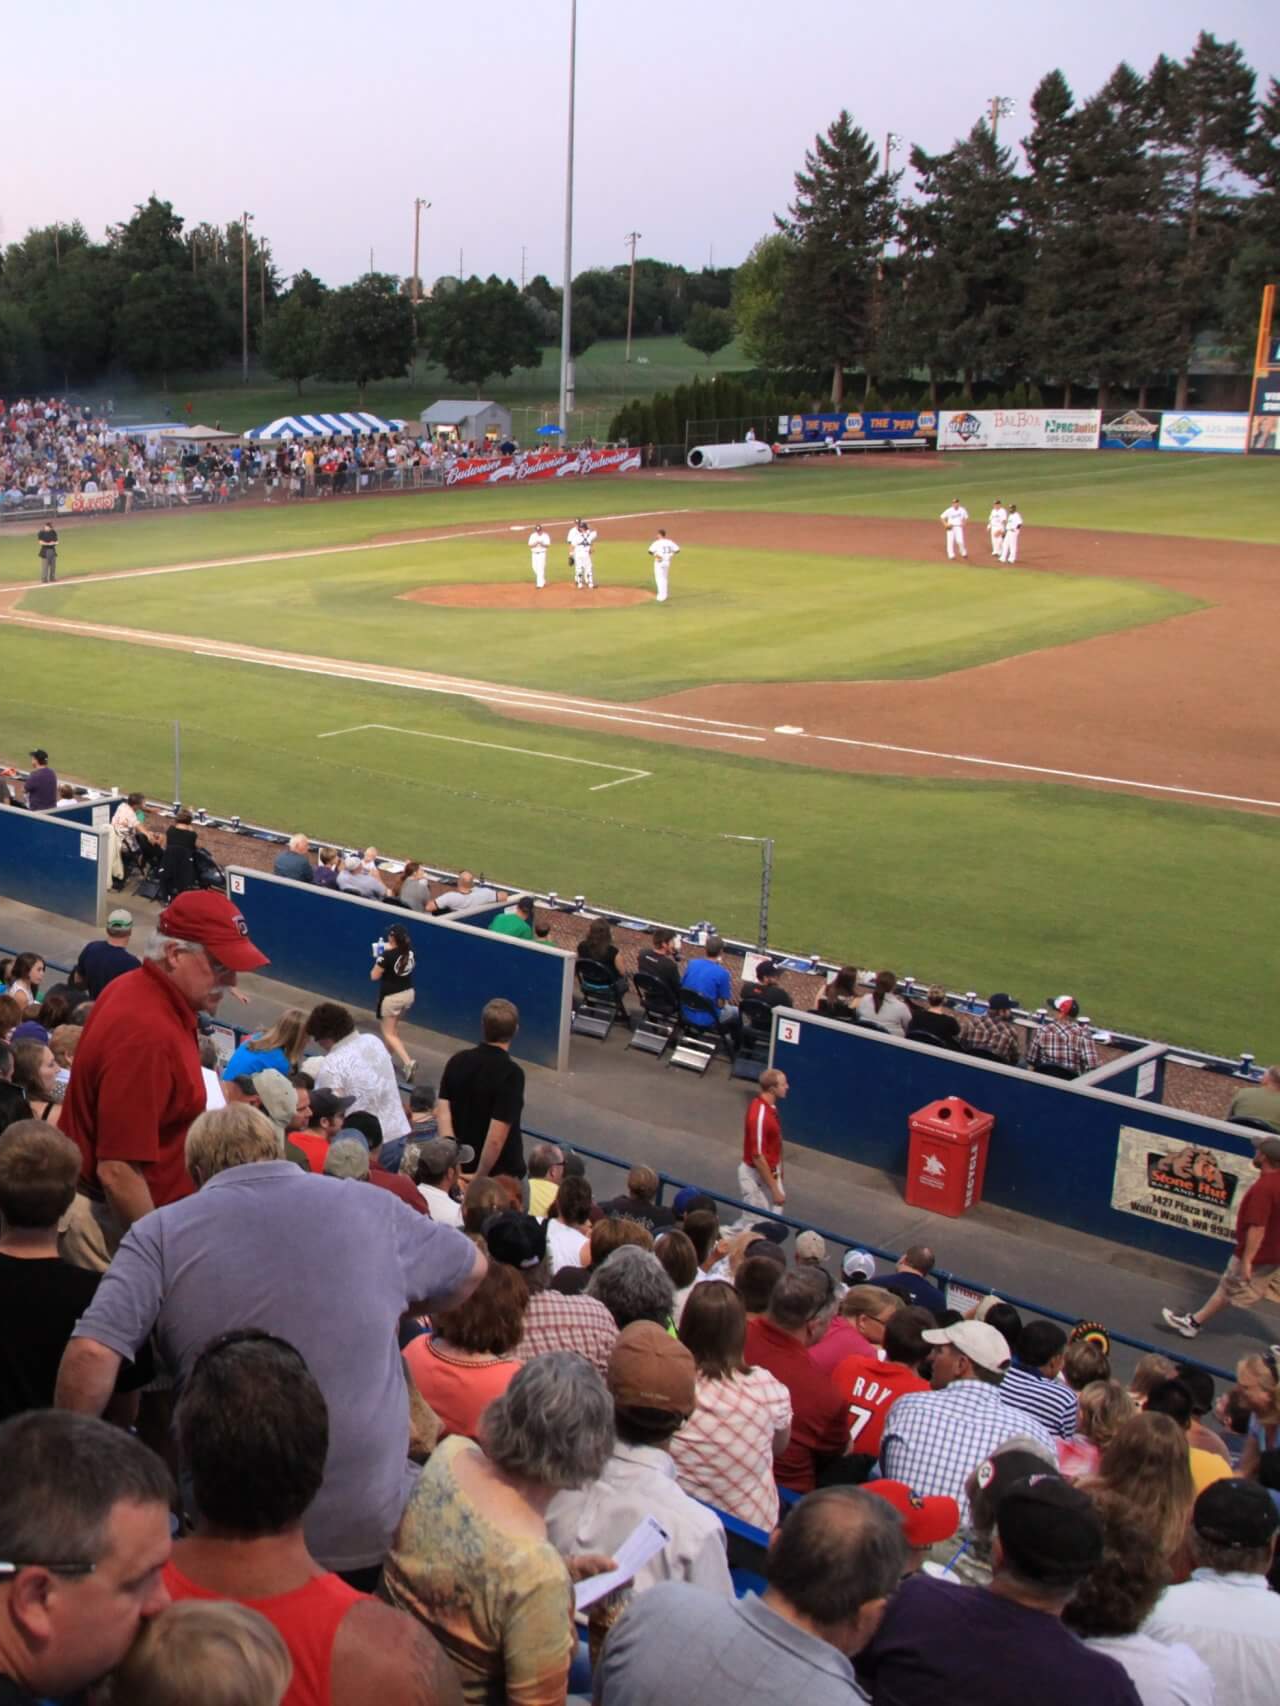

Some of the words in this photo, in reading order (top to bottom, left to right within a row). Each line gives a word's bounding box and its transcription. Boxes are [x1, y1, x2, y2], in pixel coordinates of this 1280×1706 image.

[871, 418, 890, 428] THE
[894, 419, 915, 430] PEN
[446, 460, 500, 486] Budweiser
[517, 455, 567, 480] Budweiser
[581, 451, 628, 474] Budweiser
[234, 880, 241, 891] 2
[784, 1026, 793, 1040] 3
[964, 1143, 979, 1209] RECYCLE
[1151, 1170, 1194, 1190] Stone
[1199, 1183, 1228, 1200] Hut
[1172, 1187, 1196, 1197] AND
[1130, 1201, 1158, 1216] Walla
[1192, 1218, 1208, 1232] WA
[1210, 1223, 1237, 1238] 993
[1152, 1194, 1173, 1208] 1427
[1174, 1200, 1200, 1215] Plaza
[1202, 1207, 1224, 1223] Way
[852, 1376, 893, 1406] ROY
[849, 1404, 873, 1441] 7
